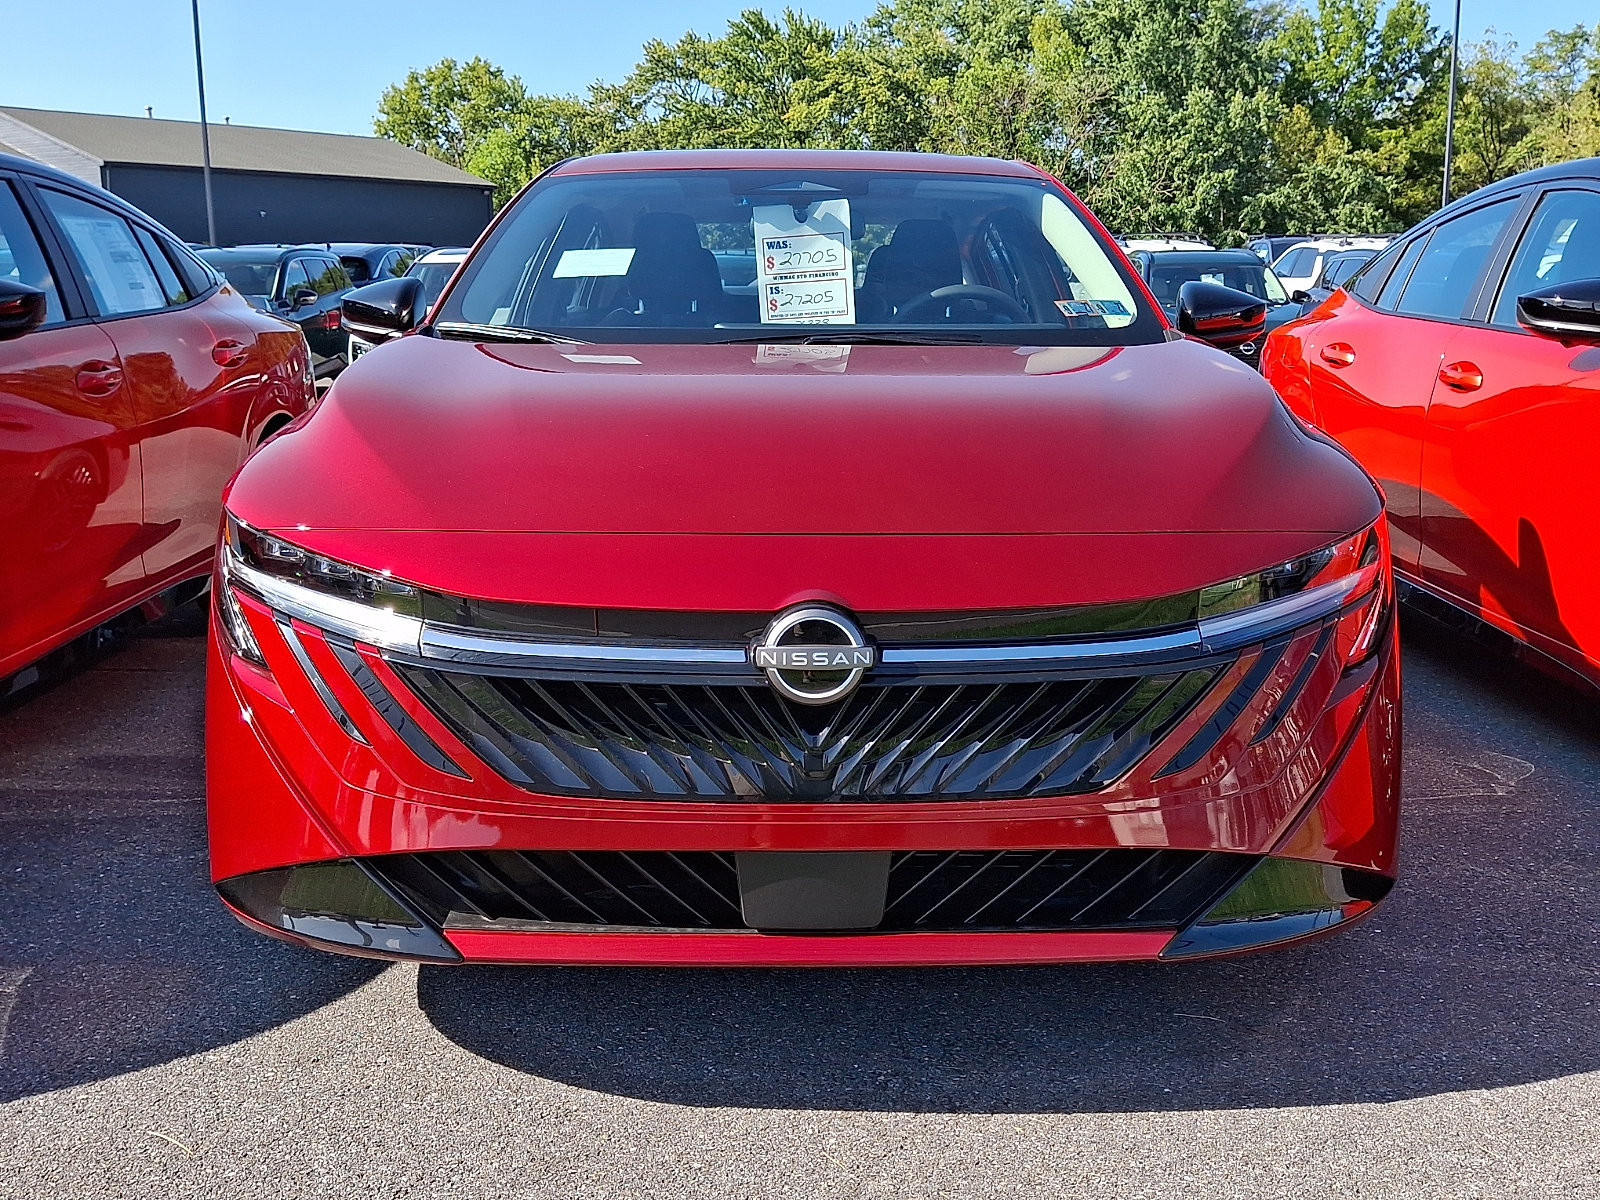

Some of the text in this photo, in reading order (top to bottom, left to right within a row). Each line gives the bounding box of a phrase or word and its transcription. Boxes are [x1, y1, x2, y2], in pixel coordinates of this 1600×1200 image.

[766, 240, 792, 250] WAS:
[766, 249, 837, 271] $ 27705
[769, 286, 784, 295] IS:
[769, 291, 833, 312] $ 27205
[760, 650, 870, 666] NISSAN
